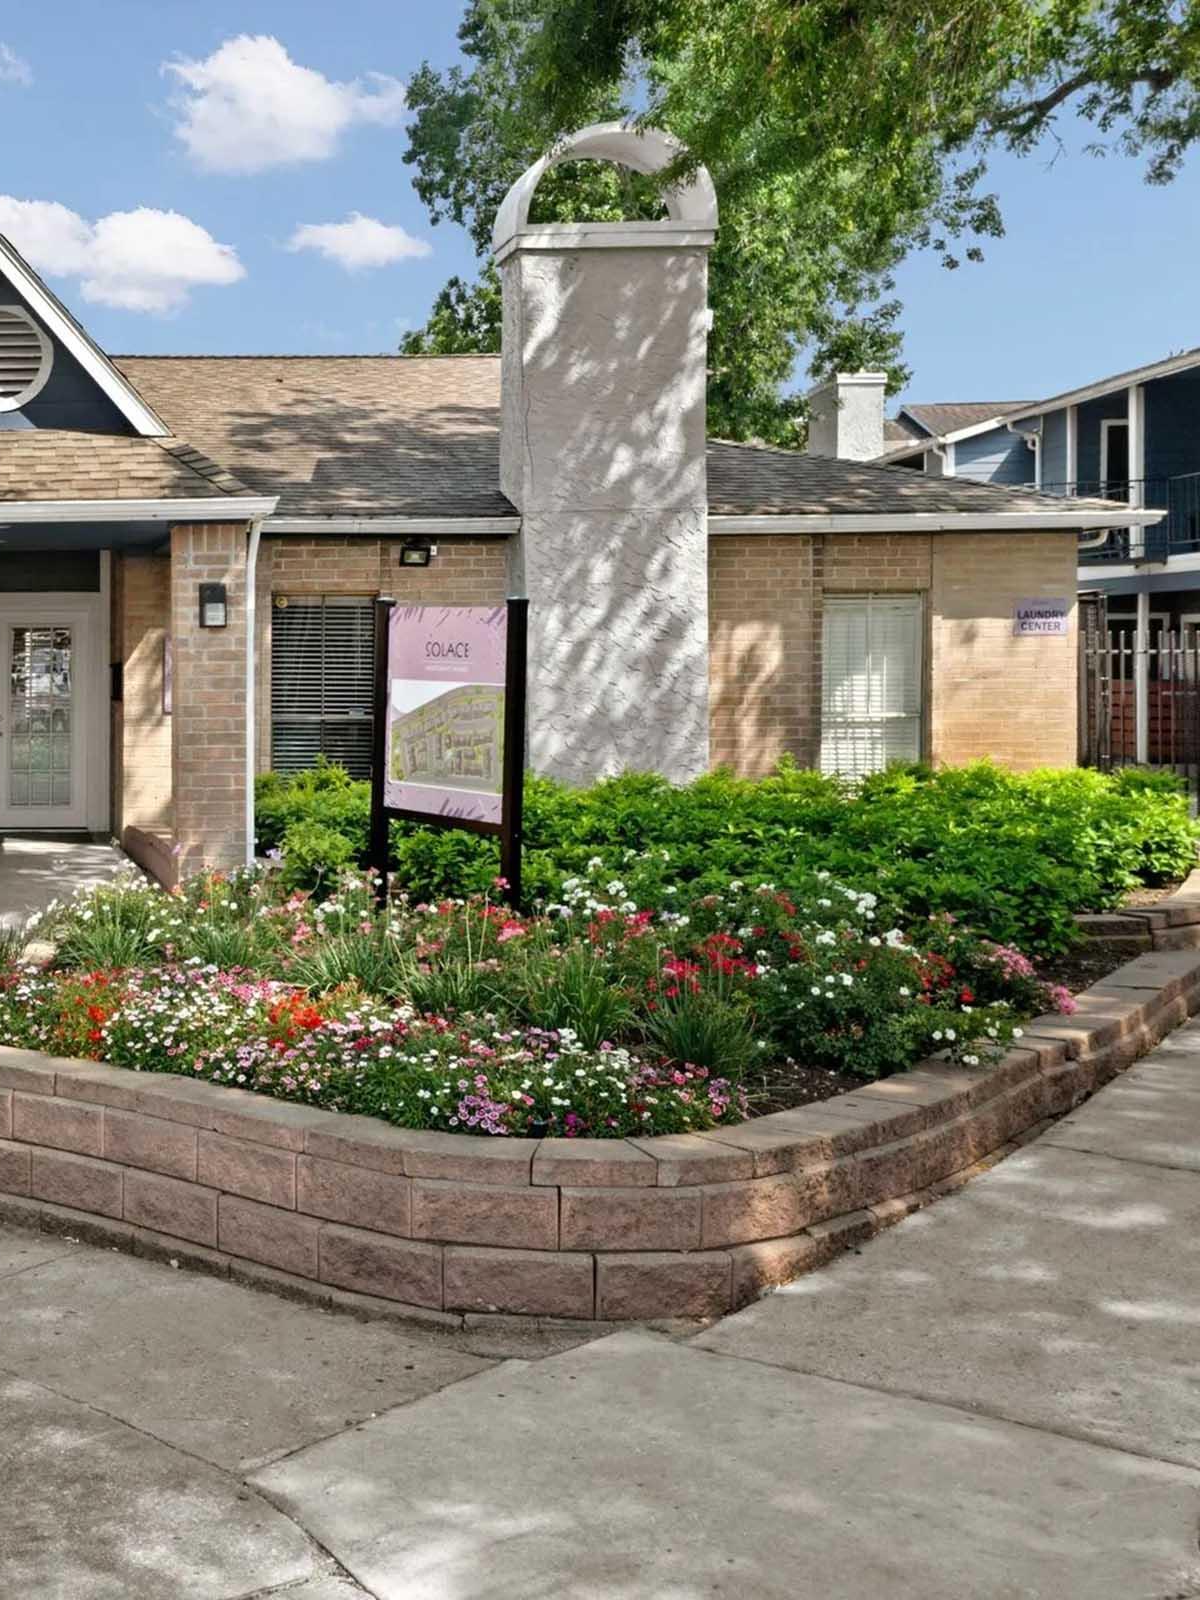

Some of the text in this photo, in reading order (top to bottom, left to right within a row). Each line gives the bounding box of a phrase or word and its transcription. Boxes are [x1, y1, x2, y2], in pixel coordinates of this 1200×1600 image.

[1016, 610, 1066, 620] LAUNDRY
[1020, 621, 1061, 631] CENTER
[424, 640, 470, 658] SOLACE
